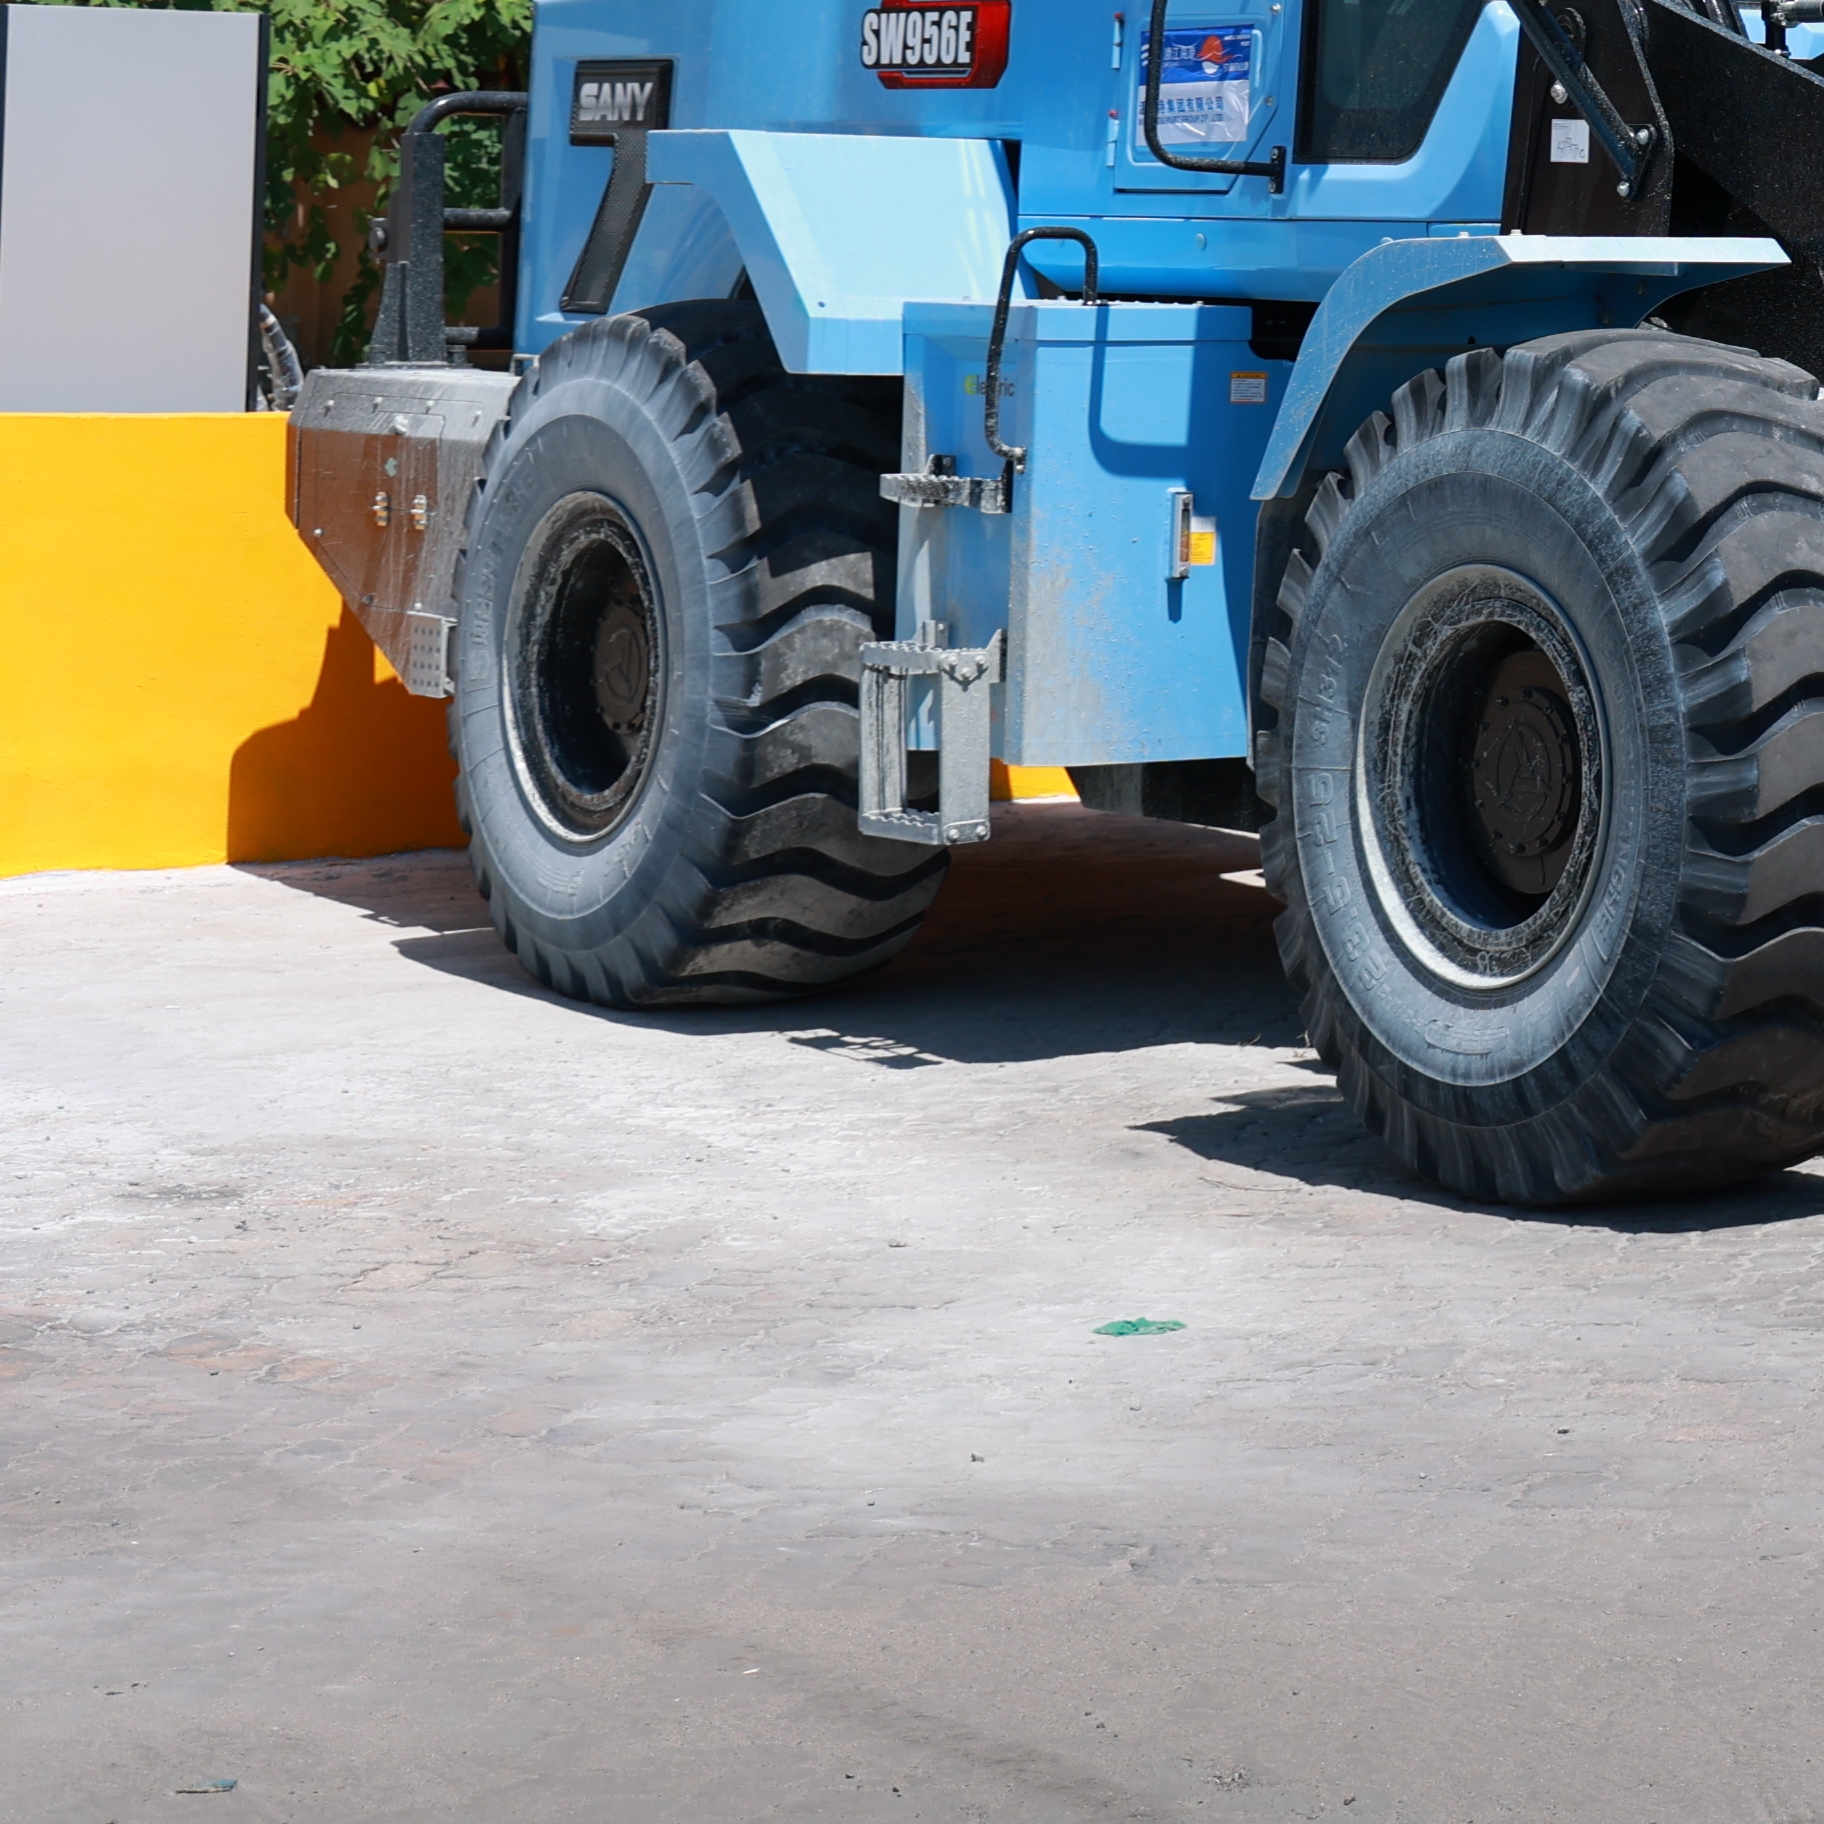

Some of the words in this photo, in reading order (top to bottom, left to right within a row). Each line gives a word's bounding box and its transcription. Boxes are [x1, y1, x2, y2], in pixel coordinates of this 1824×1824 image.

[861, 10, 973, 66] SW956E
[578, 82, 654, 121] SANY
[964, 373, 1016, 397] Eleric
[1309, 772, 1388, 991] 23.5-25
